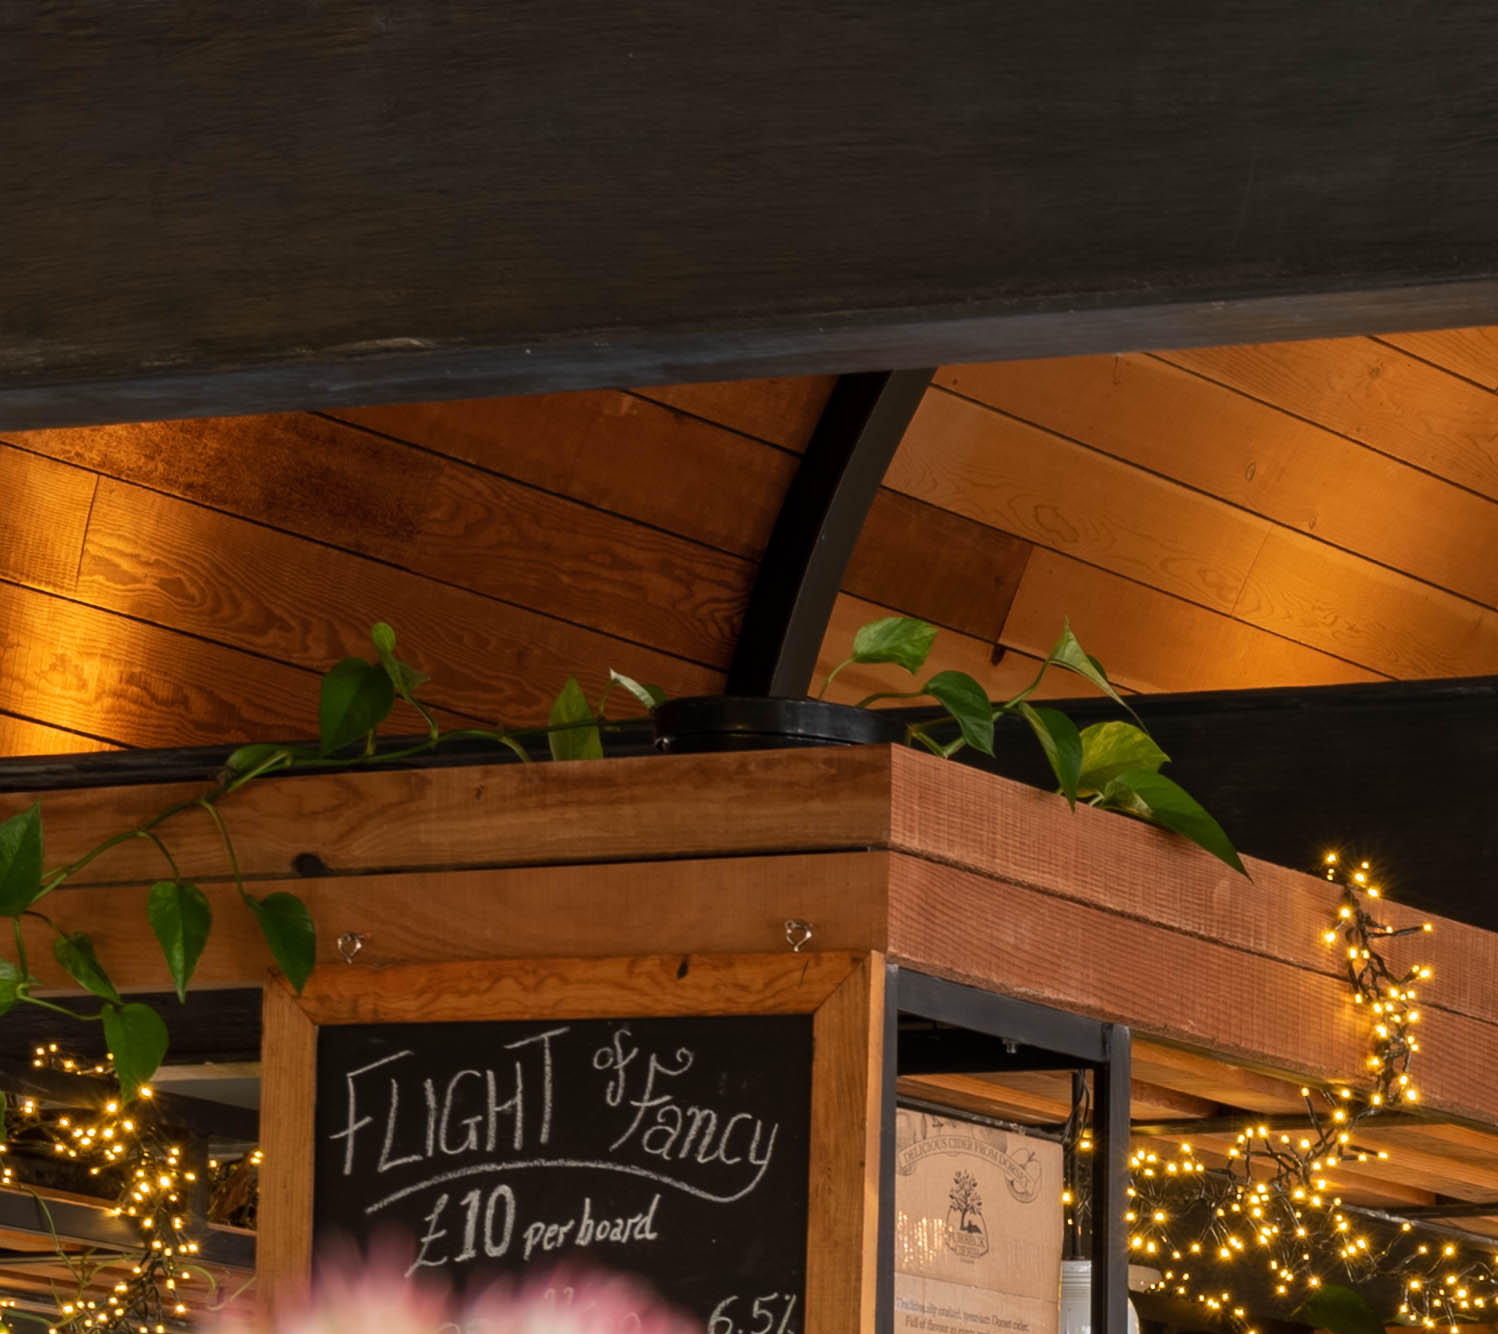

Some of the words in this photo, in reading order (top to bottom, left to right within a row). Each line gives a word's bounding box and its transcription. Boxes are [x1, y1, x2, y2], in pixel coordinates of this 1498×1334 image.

[330, 1027, 572, 1176] FLIGHT
[592, 1029, 639, 1107] of
[610, 1046, 780, 1168] Fancy
[404, 1184, 517, 1279] £10
[523, 1222, 571, 1262] per
[576, 1193, 662, 1247] board
